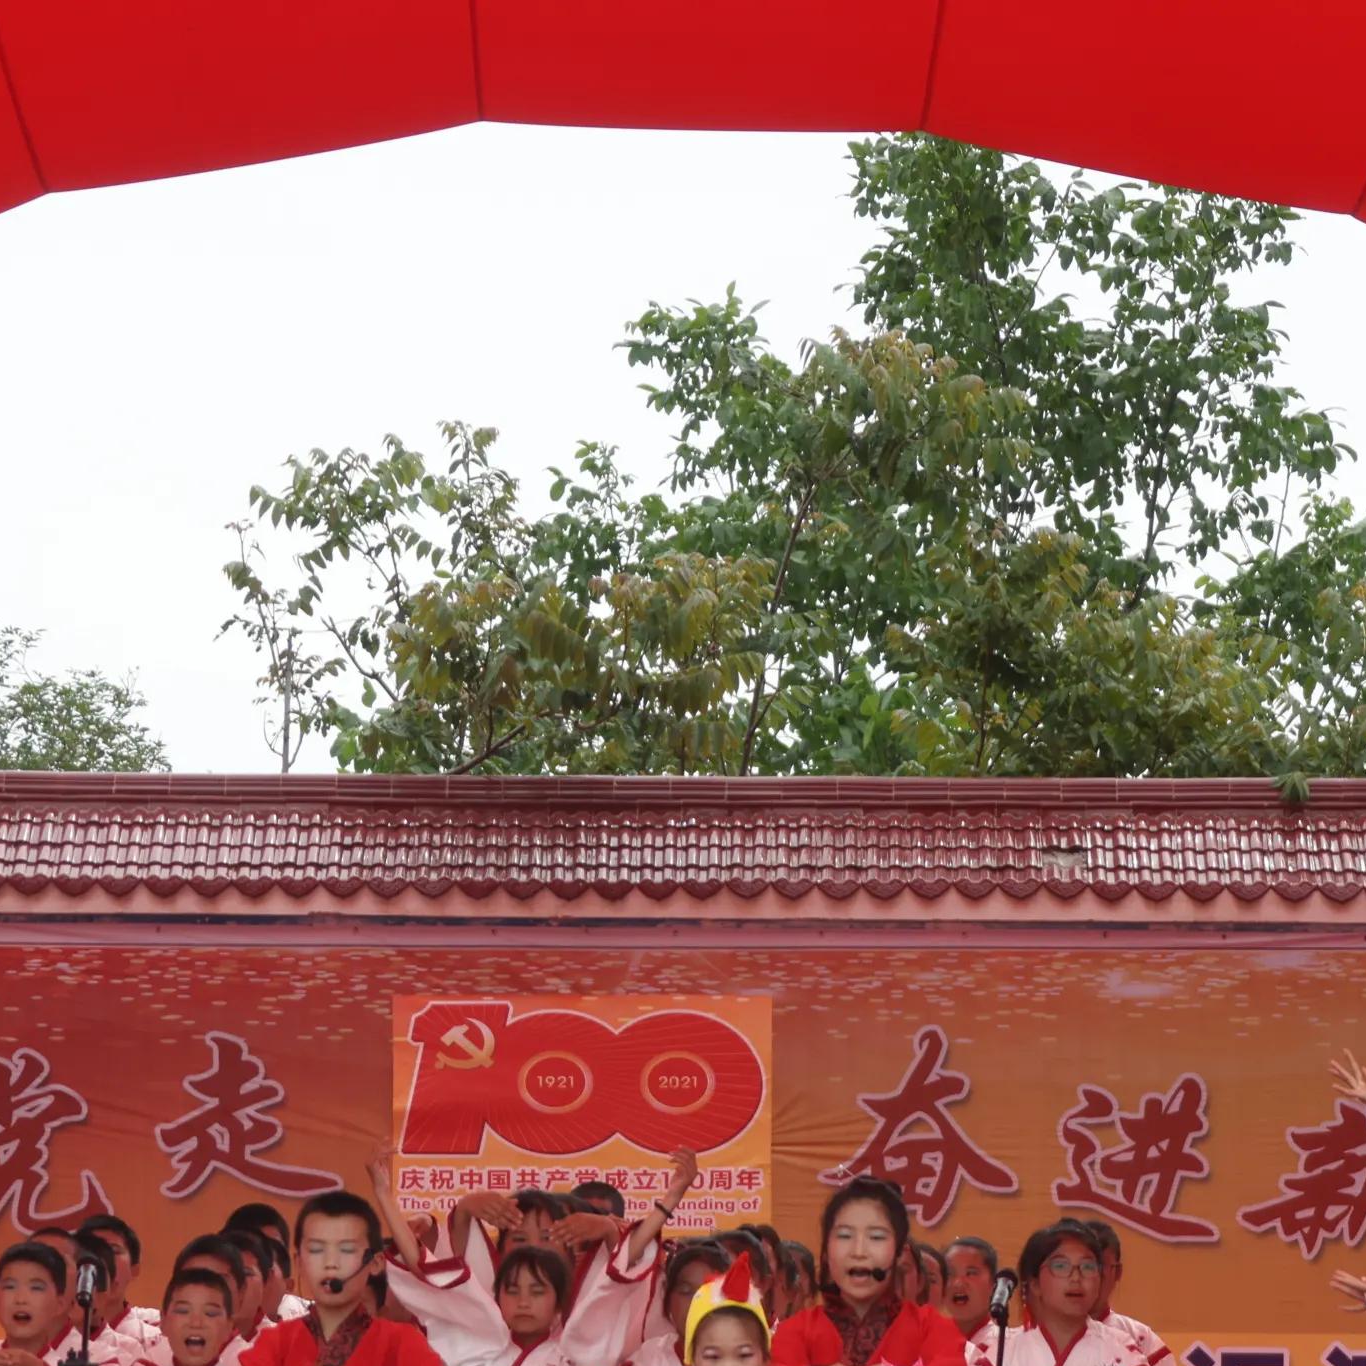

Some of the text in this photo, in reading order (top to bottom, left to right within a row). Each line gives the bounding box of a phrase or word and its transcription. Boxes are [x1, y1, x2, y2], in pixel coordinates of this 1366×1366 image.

[537, 1075, 575, 1090] 1921
[658, 1075, 698, 1090] 2021
[400, 1168, 761, 1191] 庆祝中国共产党成立10周年
[401, 1198, 431, 1209] The
[626, 1198, 648, 1210] he
[742, 1198, 760, 1210] of
